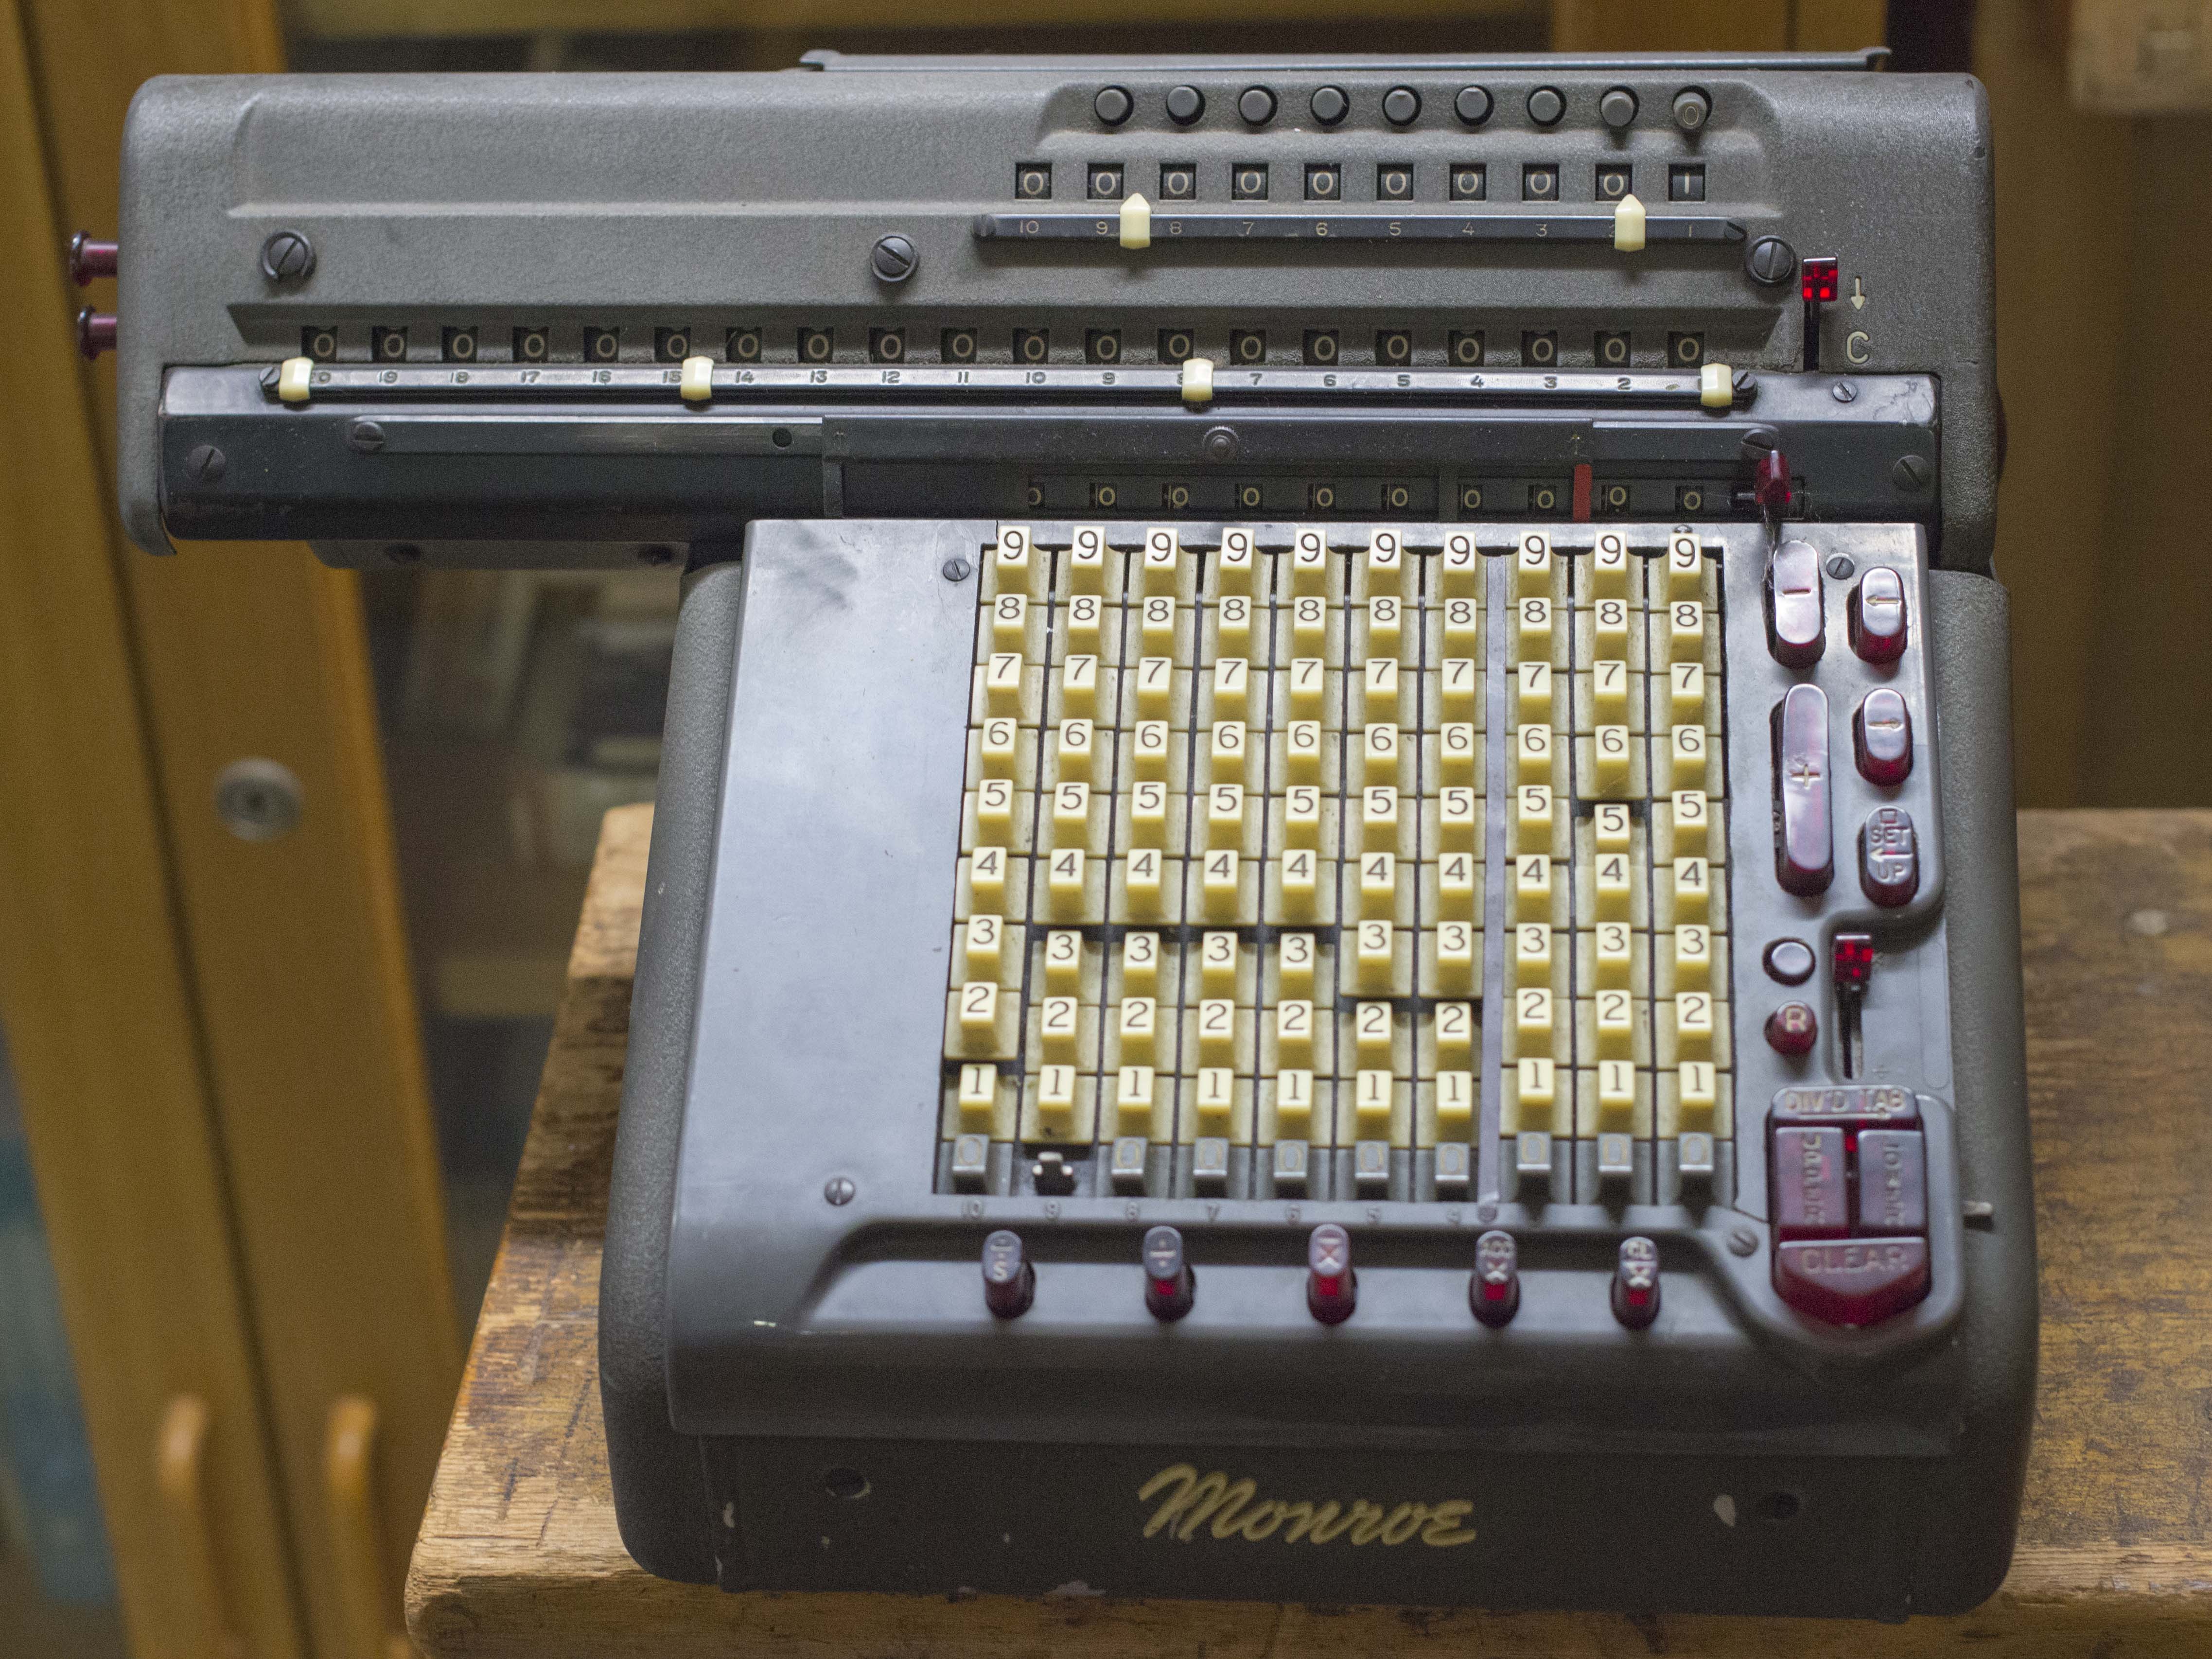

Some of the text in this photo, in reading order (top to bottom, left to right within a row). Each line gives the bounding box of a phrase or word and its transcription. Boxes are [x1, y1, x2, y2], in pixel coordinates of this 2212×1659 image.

[1684, 105, 1699, 126] 0
[1023, 171, 1043, 193] 0
[1096, 171, 1116, 194] 0
[1168, 171, 1189, 194] 0
[1241, 171, 1261, 192] 0
[1313, 171, 1333, 194] 0
[1386, 172, 1406, 194] 0
[1457, 172, 1478, 193] 0
[1530, 172, 1551, 194] 0
[1603, 174, 1624, 195] 0
[1020, 221, 1694, 237] 10 9 8 7 6 5 4 3 1
[314, 334, 1625, 362] 0 0 0 0 0 0 0 0 0 0
[1847, 331, 1870, 364] C
[378, 370, 1632, 391] 19 18 17 16 15 14 13 12 11 10 9 7 6 5 4 3 2
[1004, 530, 1695, 568] 9 9 9 9 9 9 9 9 9 9
[999, 597, 1698, 627] 8 8 8 8 8 8 8 8 8 8
[996, 656, 1697, 688] 7 7 7 7 7 7 7 7 7 7
[989, 721, 1700, 752] 6 6 6 6 6 6 6 6 6 6
[985, 783, 1702, 832] 5 5 5 5 5 5 5 5 5 5
[1871, 827, 1911, 846] SET
[977, 851, 1702, 886] 4 4 4 4 4 4 4 4 4 4
[1876, 862, 1907, 880] UP
[973, 919, 1705, 962] 3 3 3 3 3 3 3 3 3 3
[967, 986, 1704, 1033] 2 2 2 2 2 2 2 2 2 2
[1784, 1007, 1808, 1033] R
[970, 1061, 1703, 1101] 1 1 1 1 1 1 1 1 1 1
[1858, 1089, 1907, 1113] TAB
[1802, 1247, 1908, 1275] CLEAR
[1139, 1463, 1476, 1547] Monroe
